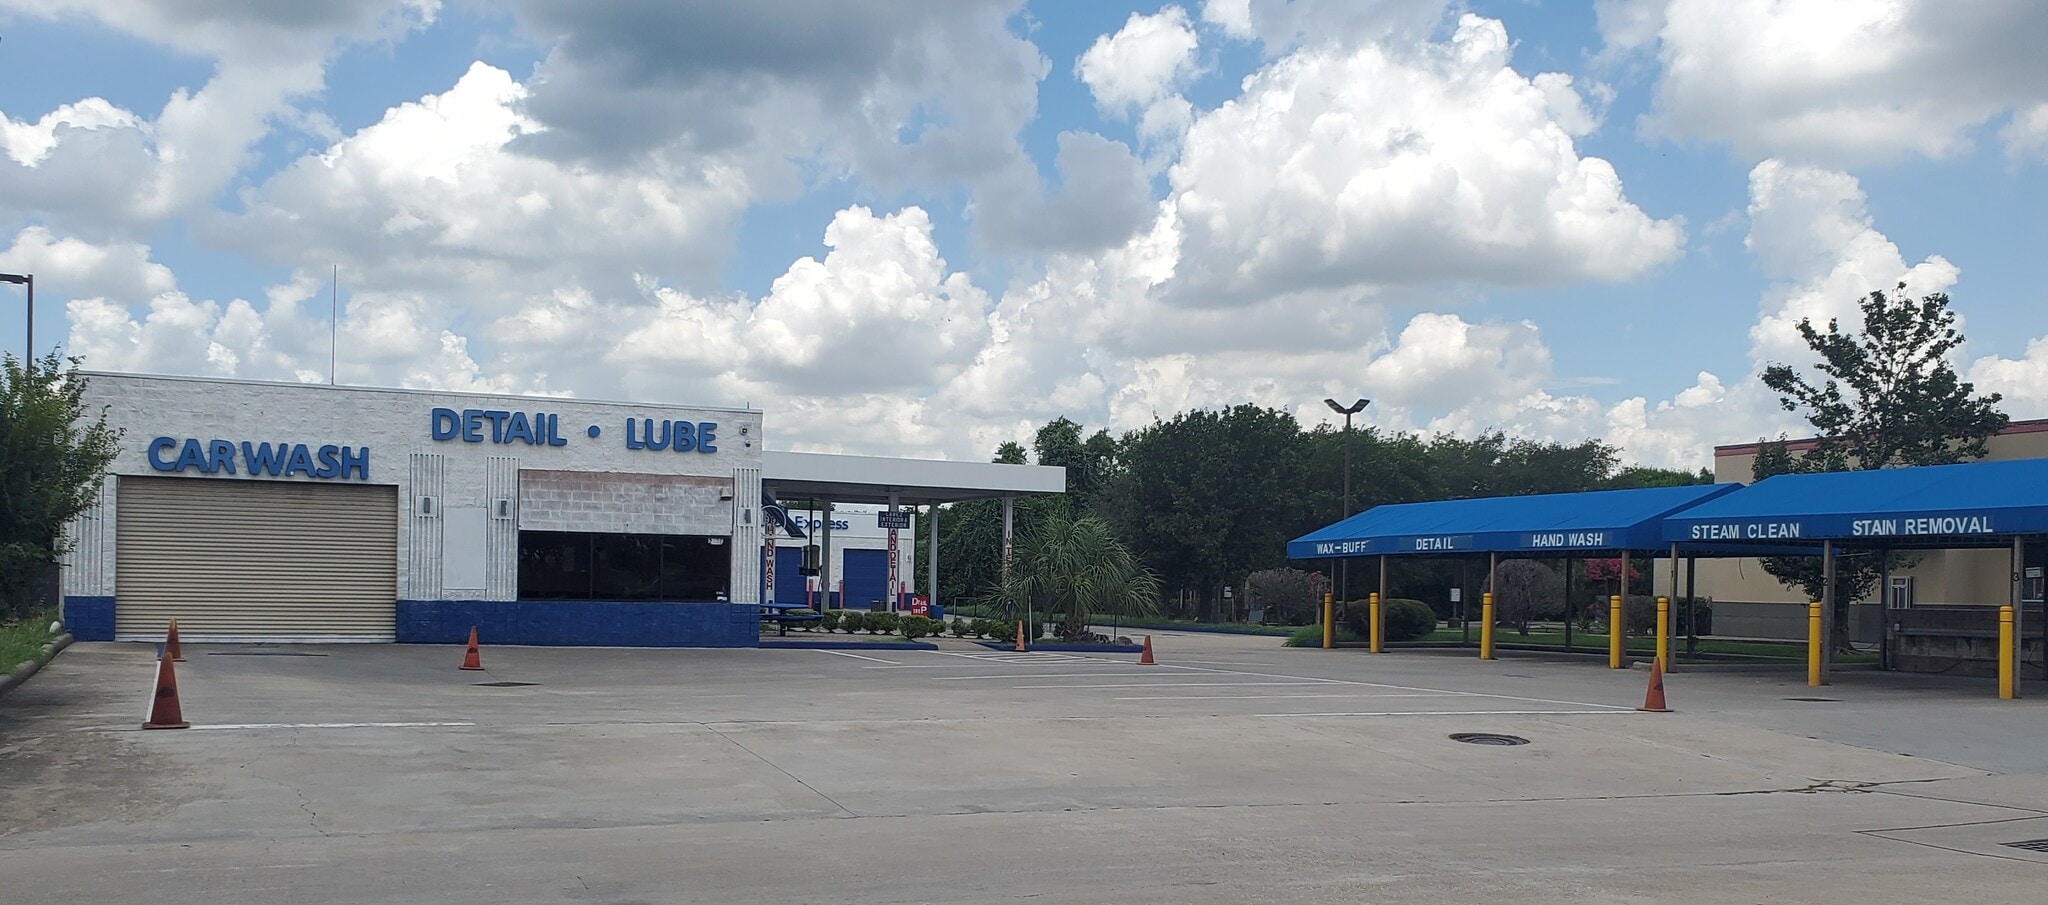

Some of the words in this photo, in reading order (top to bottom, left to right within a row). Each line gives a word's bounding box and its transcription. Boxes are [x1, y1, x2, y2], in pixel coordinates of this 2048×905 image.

[431, 407, 567, 447] DETAIL
[626, 417, 718, 453] LUBE
[148, 436, 237, 474] CAR
[241, 441, 370, 480] WASH
[795, 516, 849, 532] Expess
[1691, 524, 1740, 540] STEAM
[1747, 522, 1800, 539] CLEAN
[1852, 519, 1897, 536] STAIN
[1905, 516, 1993, 534] REMOVAL
[1316, 541, 1367, 555] WAX-BUFF
[1416, 537, 1454, 550] DETAIL
[1532, 534, 1563, 547] HAND
[1568, 532, 1603, 546] WASH
[766, 560, 774, 590] WASH
[2013, 572, 2020, 582] 3
